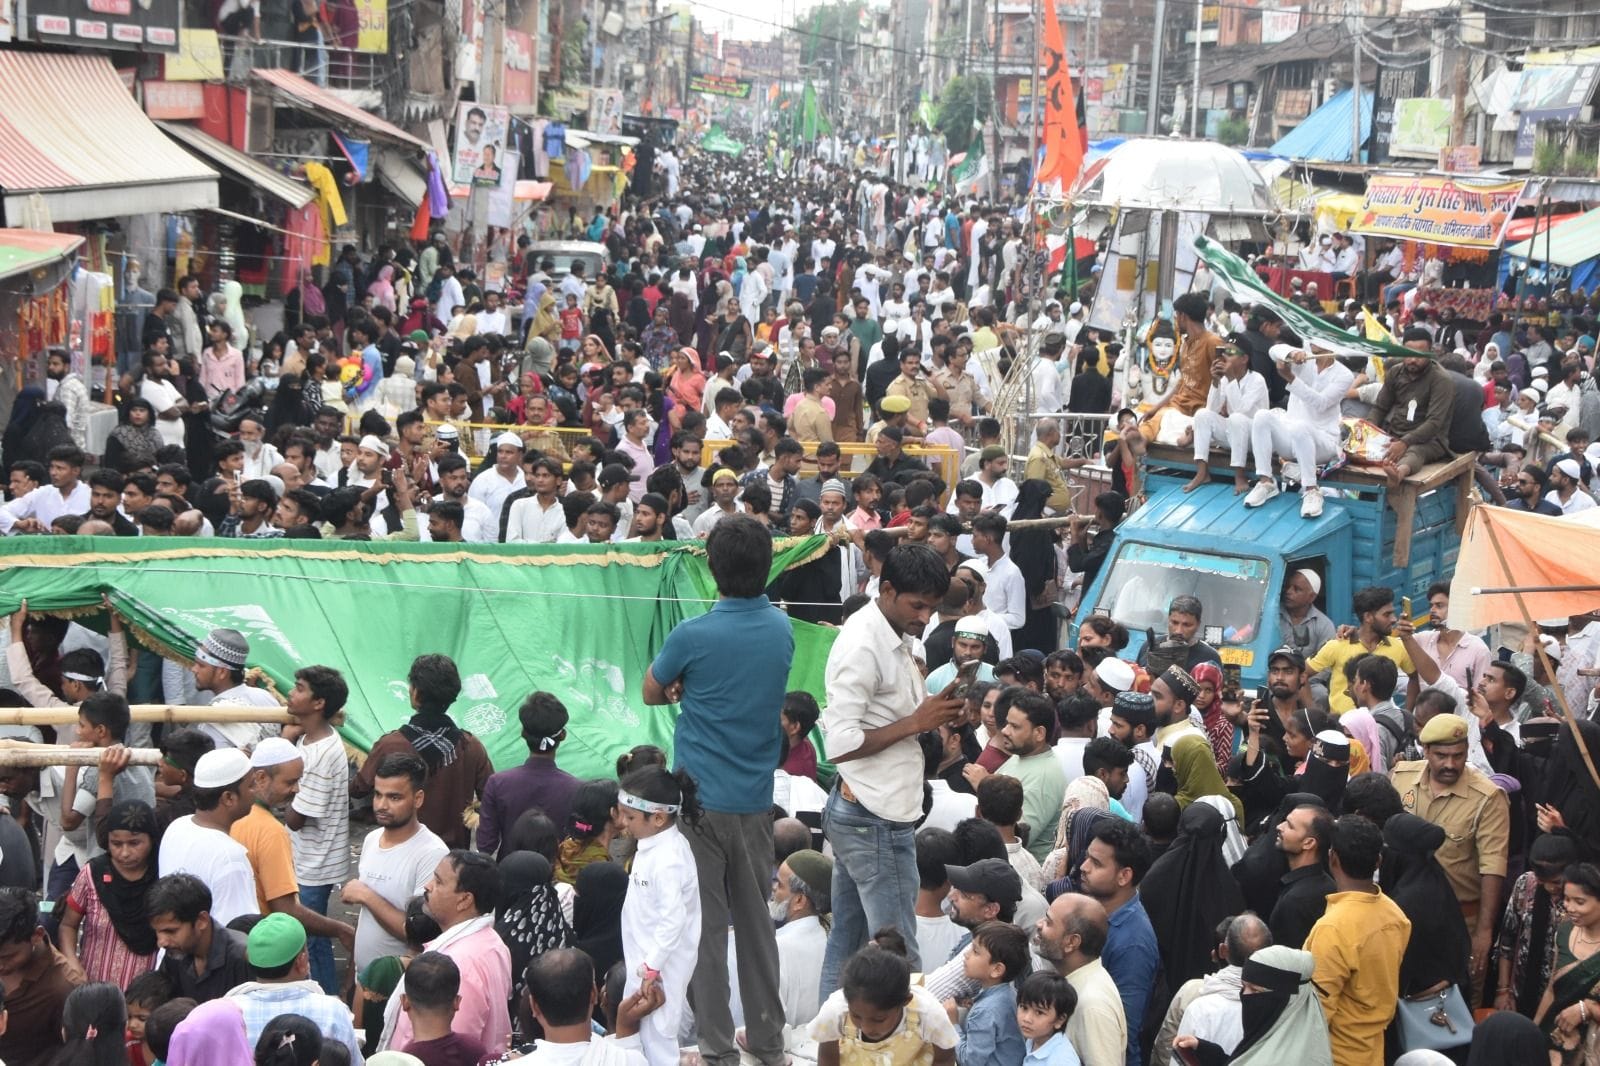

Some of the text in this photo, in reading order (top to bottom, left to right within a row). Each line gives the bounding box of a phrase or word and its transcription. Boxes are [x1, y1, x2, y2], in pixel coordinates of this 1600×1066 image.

[1401, 181, 1419, 206] श्री
[1413, 187, 1439, 214] गुरु
[1436, 182, 1462, 210] सिंह
[1411, 218, 1434, 234] स्वागत
